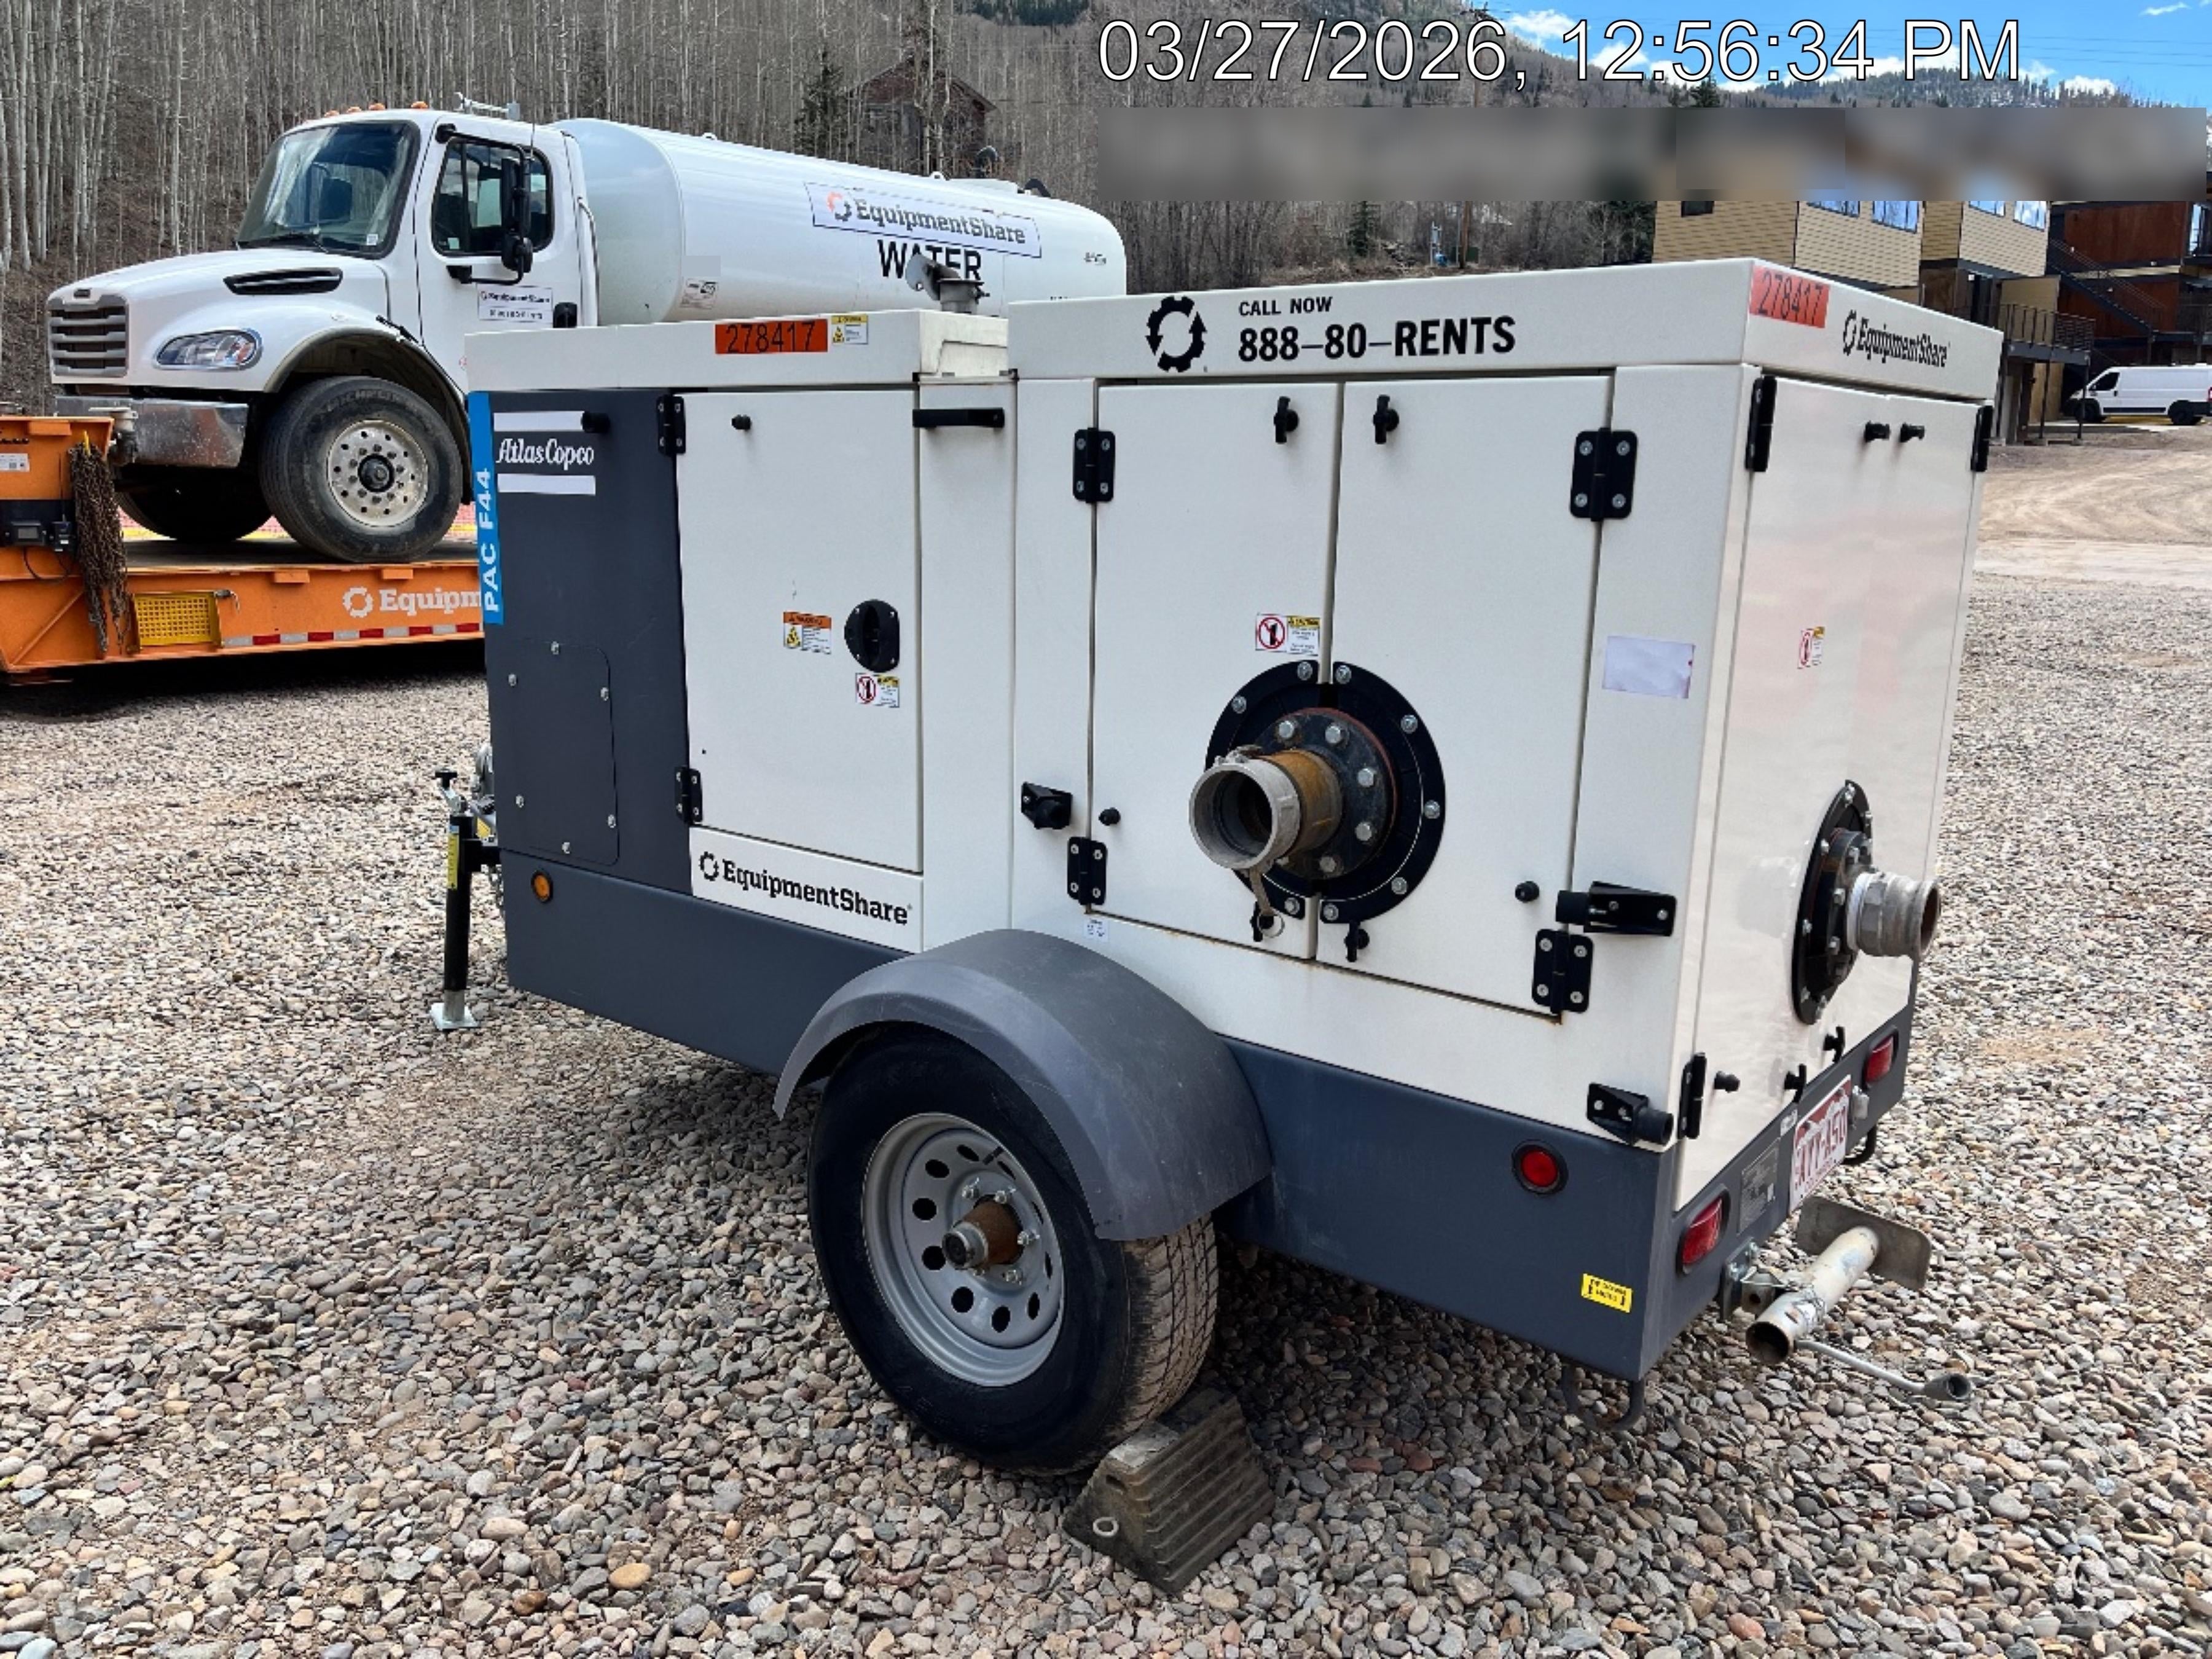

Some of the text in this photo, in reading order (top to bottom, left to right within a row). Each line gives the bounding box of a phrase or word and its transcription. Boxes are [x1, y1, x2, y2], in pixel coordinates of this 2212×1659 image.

[853, 198, 1026, 244] EquipmentShare
[877, 239, 982, 280] WTER
[1238, 296, 1333, 316] CALL NOW
[1758, 270, 1824, 325] 278417
[726, 321, 815, 355] 278417
[1856, 316, 1948, 368] EquipmentShare
[476, 468, 499, 613] PAC F44
[722, 858, 908, 925] EquipmentShare
